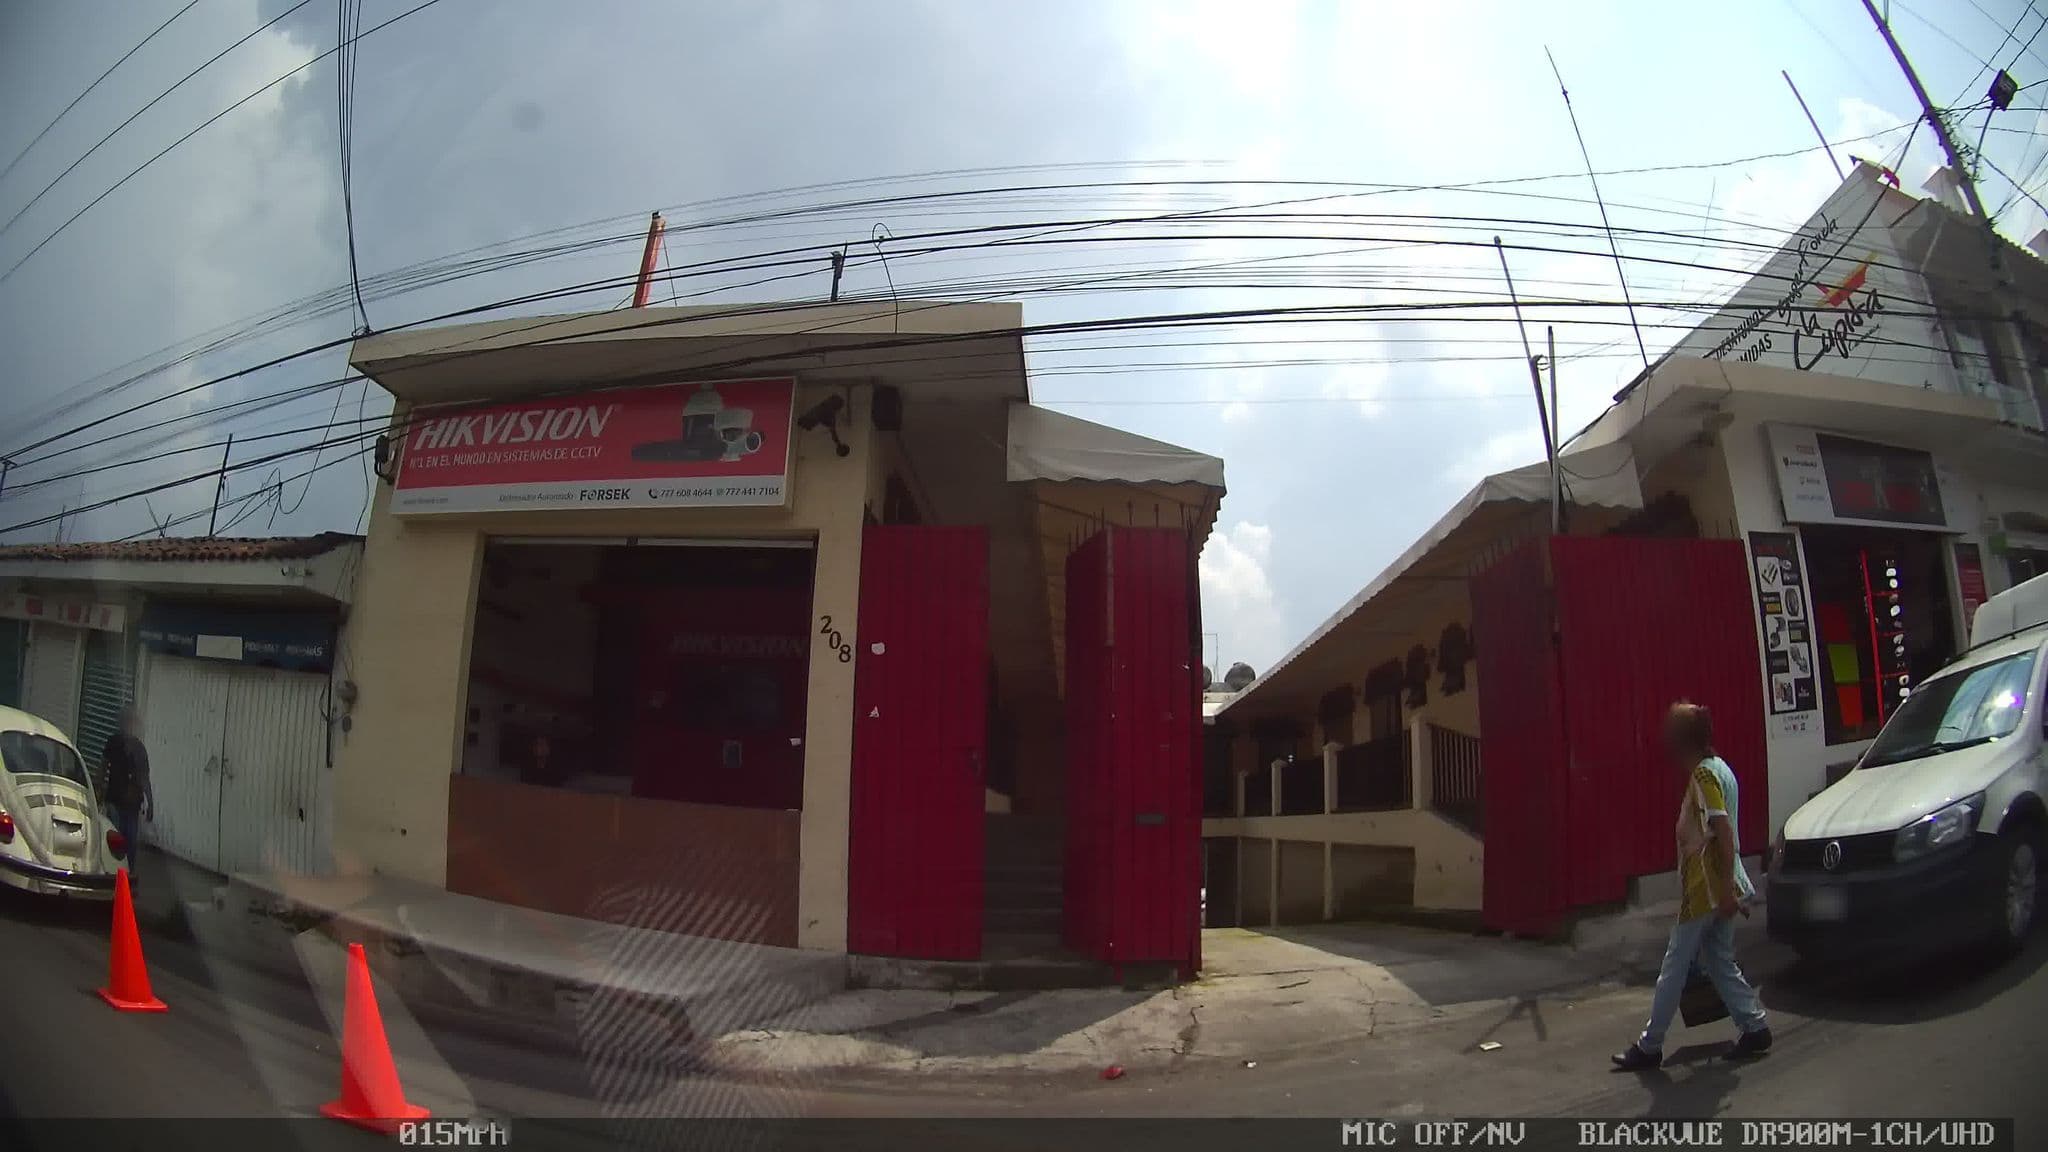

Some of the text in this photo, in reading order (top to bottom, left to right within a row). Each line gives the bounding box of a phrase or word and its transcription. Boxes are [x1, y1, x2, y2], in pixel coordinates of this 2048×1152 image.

[413, 403, 613, 451] HIKVISION
[425, 455, 438, 468] EN
[439, 455, 451, 467] EL
[453, 452, 486, 466] MUNDO
[487, 451, 501, 464] EN
[502, 449, 552, 463] SISTEMAS
[553, 448, 568, 460] DE
[570, 446, 601, 459] CCTV
[580, 488, 631, 501] FORSEK
[759, 487, 780, 496] 7104
[819, 615, 852, 663] 208
